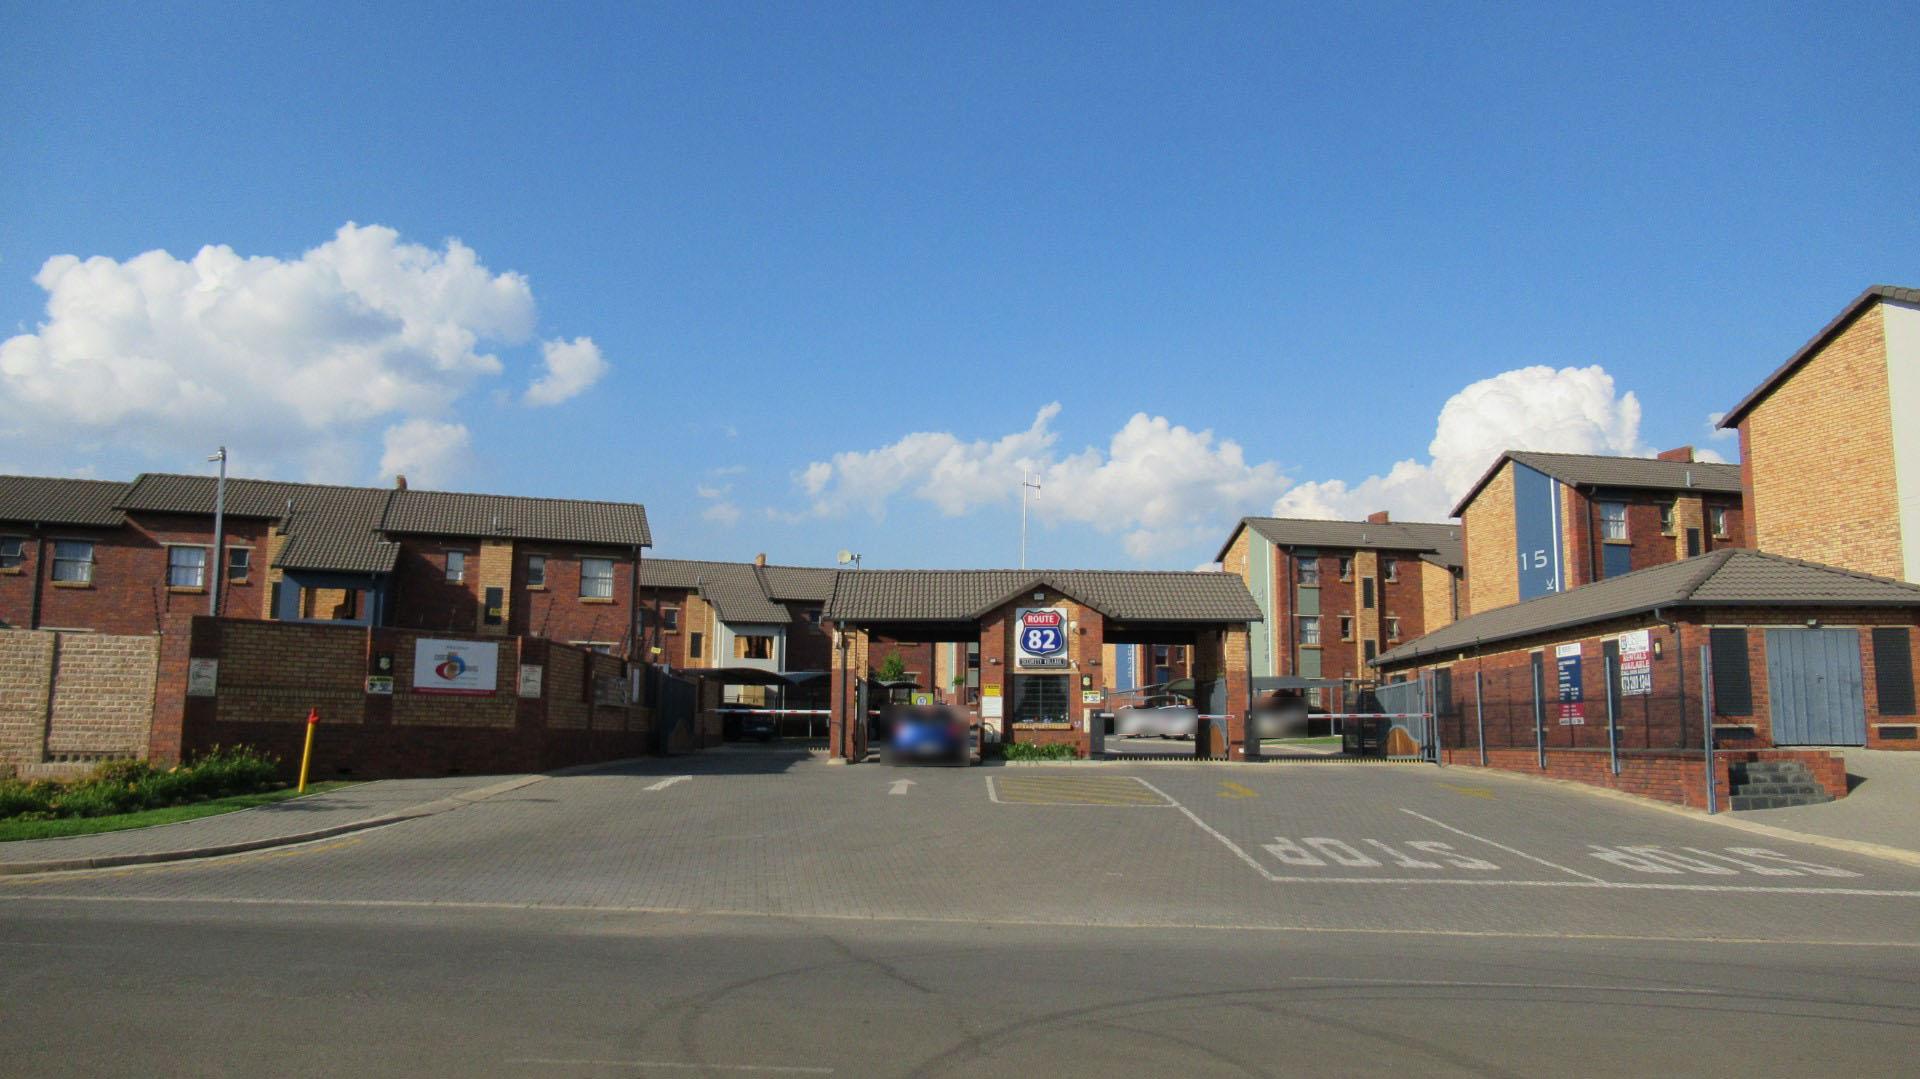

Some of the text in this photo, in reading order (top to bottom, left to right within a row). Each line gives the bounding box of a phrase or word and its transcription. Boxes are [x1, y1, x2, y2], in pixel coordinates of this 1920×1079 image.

[1520, 549, 1548, 571] 15
[1028, 615, 1054, 623] ROUTE
[1028, 629, 1056, 649] 82
[1621, 660, 1650, 670] AVAILABLE
[1622, 652, 1647, 662] RENTALS
[1261, 836, 1502, 870] STOP
[1586, 844, 1865, 878] STOP
